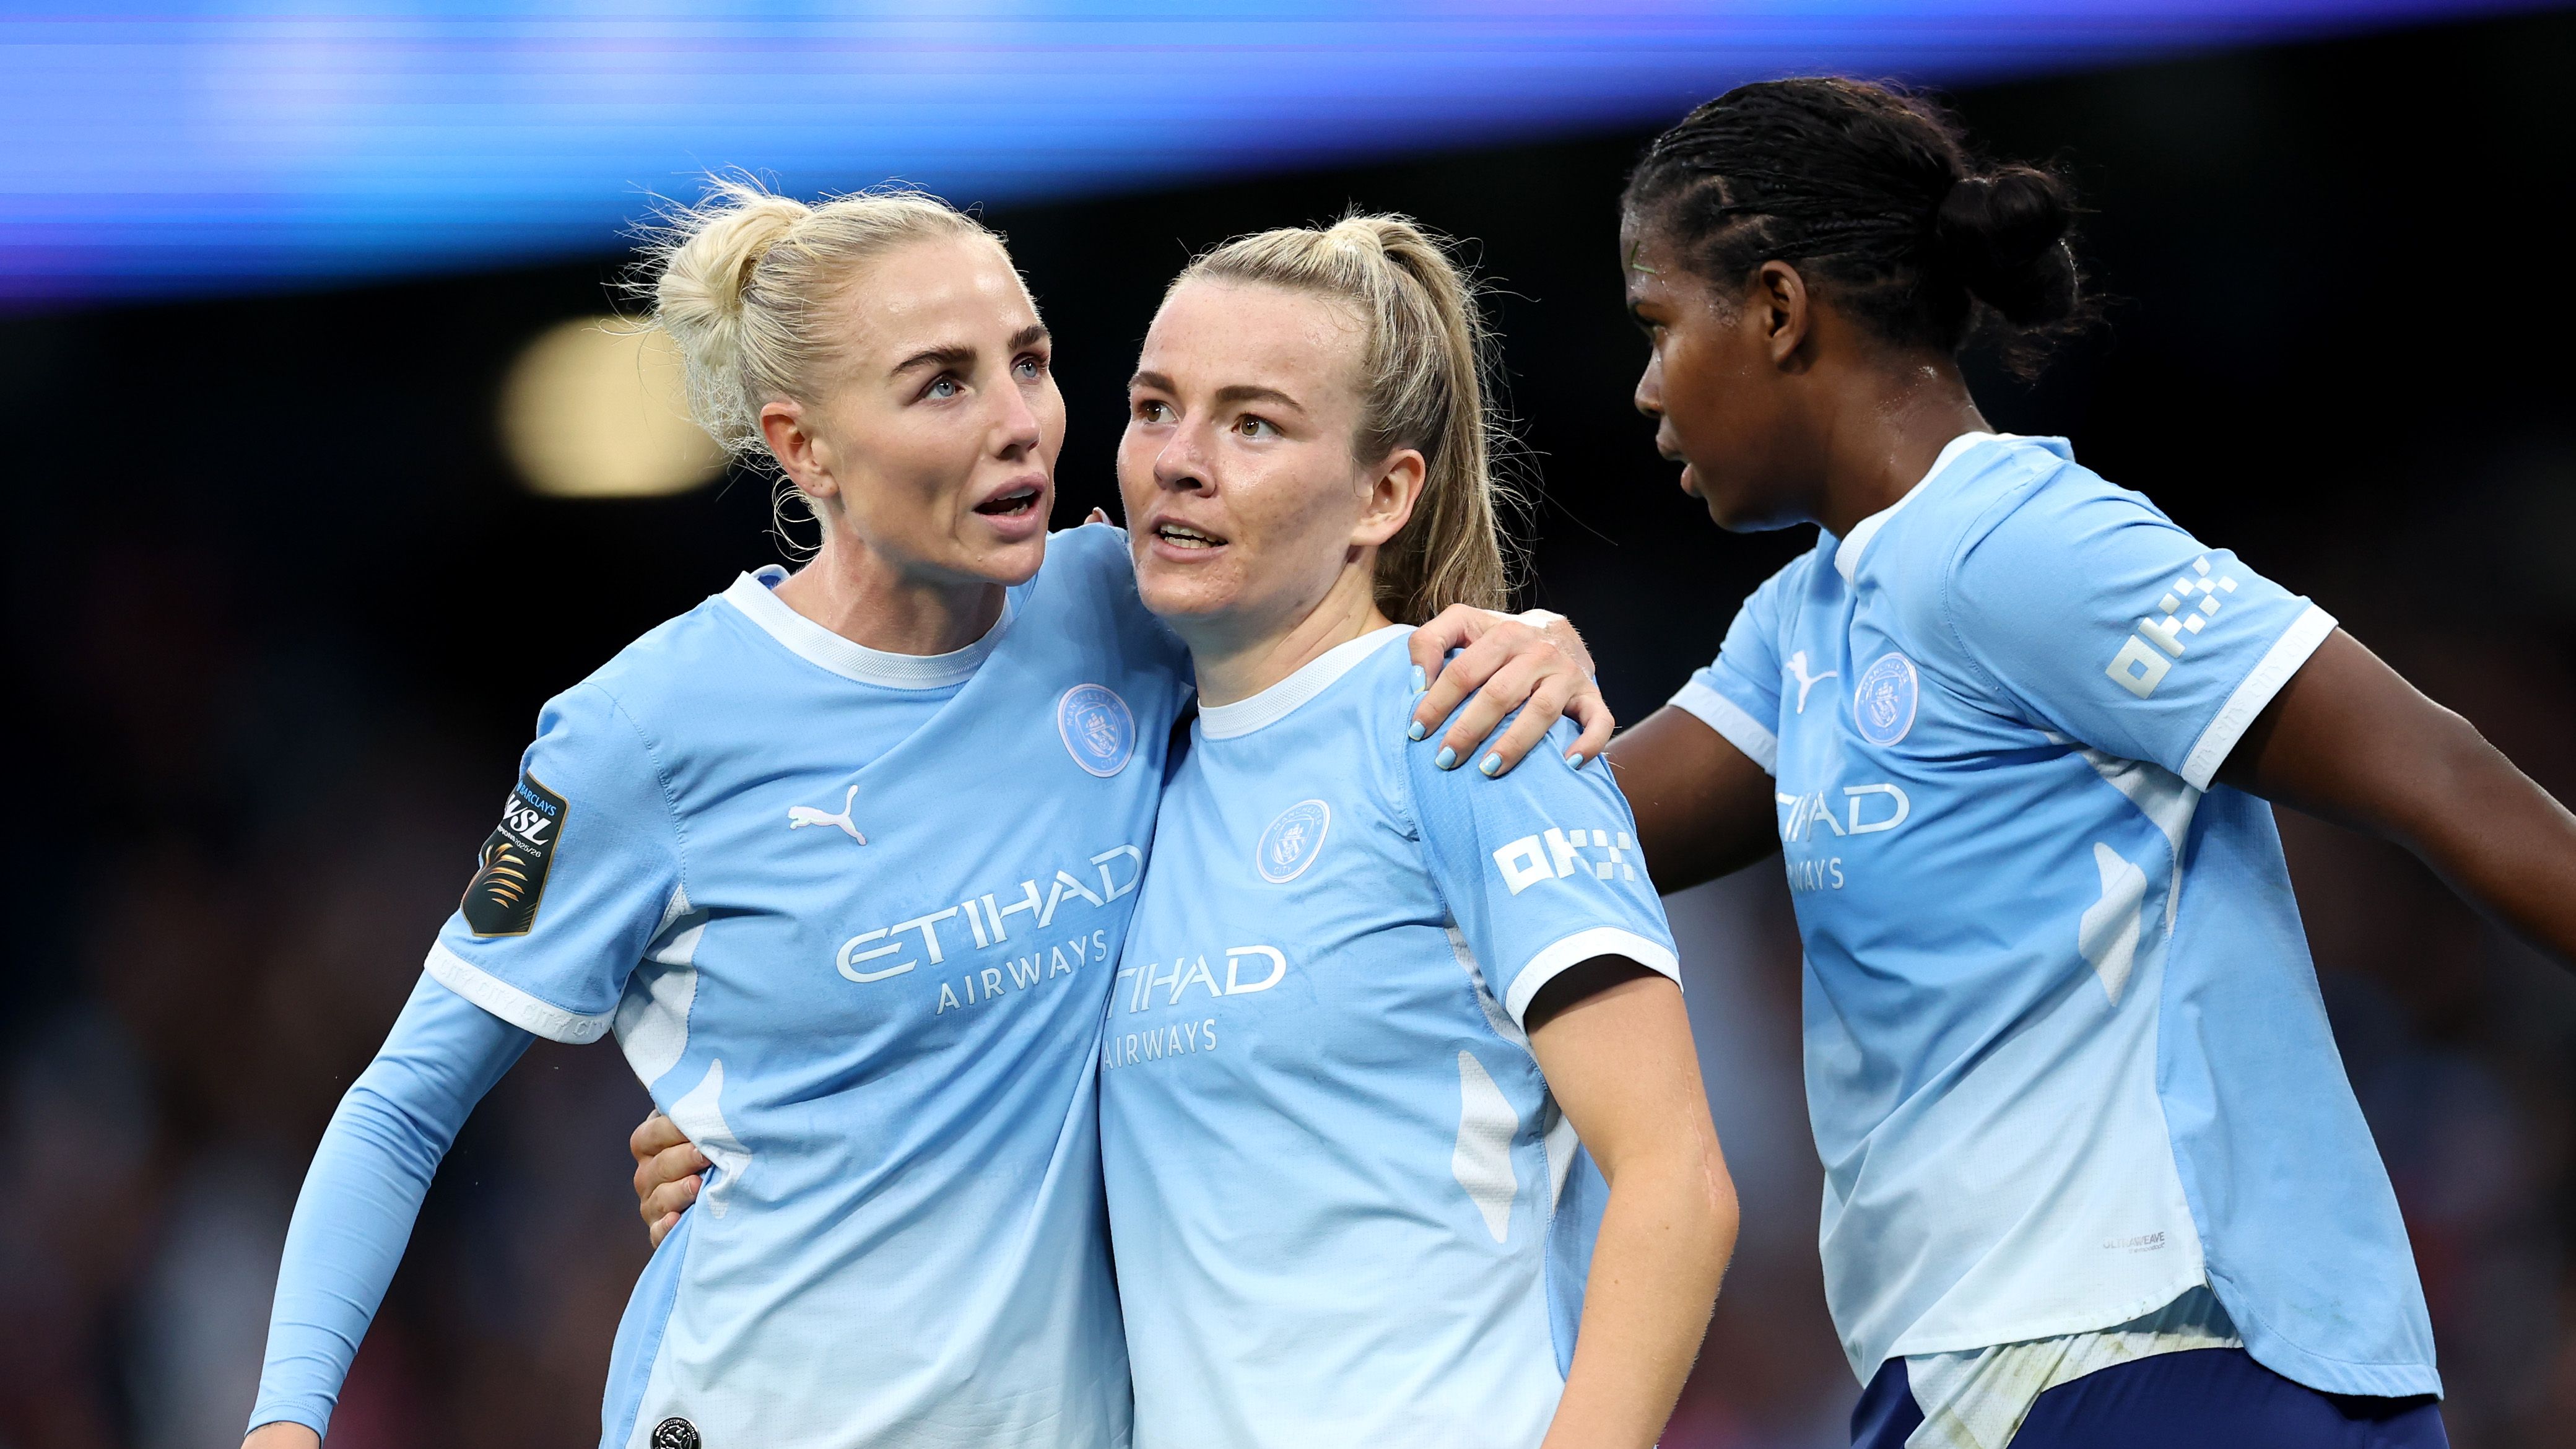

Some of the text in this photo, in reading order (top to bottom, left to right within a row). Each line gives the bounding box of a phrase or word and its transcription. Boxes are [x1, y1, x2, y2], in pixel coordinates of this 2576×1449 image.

[1100, 757, 1118, 768] CITY
[520, 783, 557, 816] BARCLAYS
[1273, 865, 1291, 874] CITY
[836, 844, 1143, 983] ETIHAD
[936, 929, 1108, 1016] AIRWAYS
[1107, 944, 1287, 1020] TIHAD
[1102, 1019, 1217, 1073] AIRWAYS
